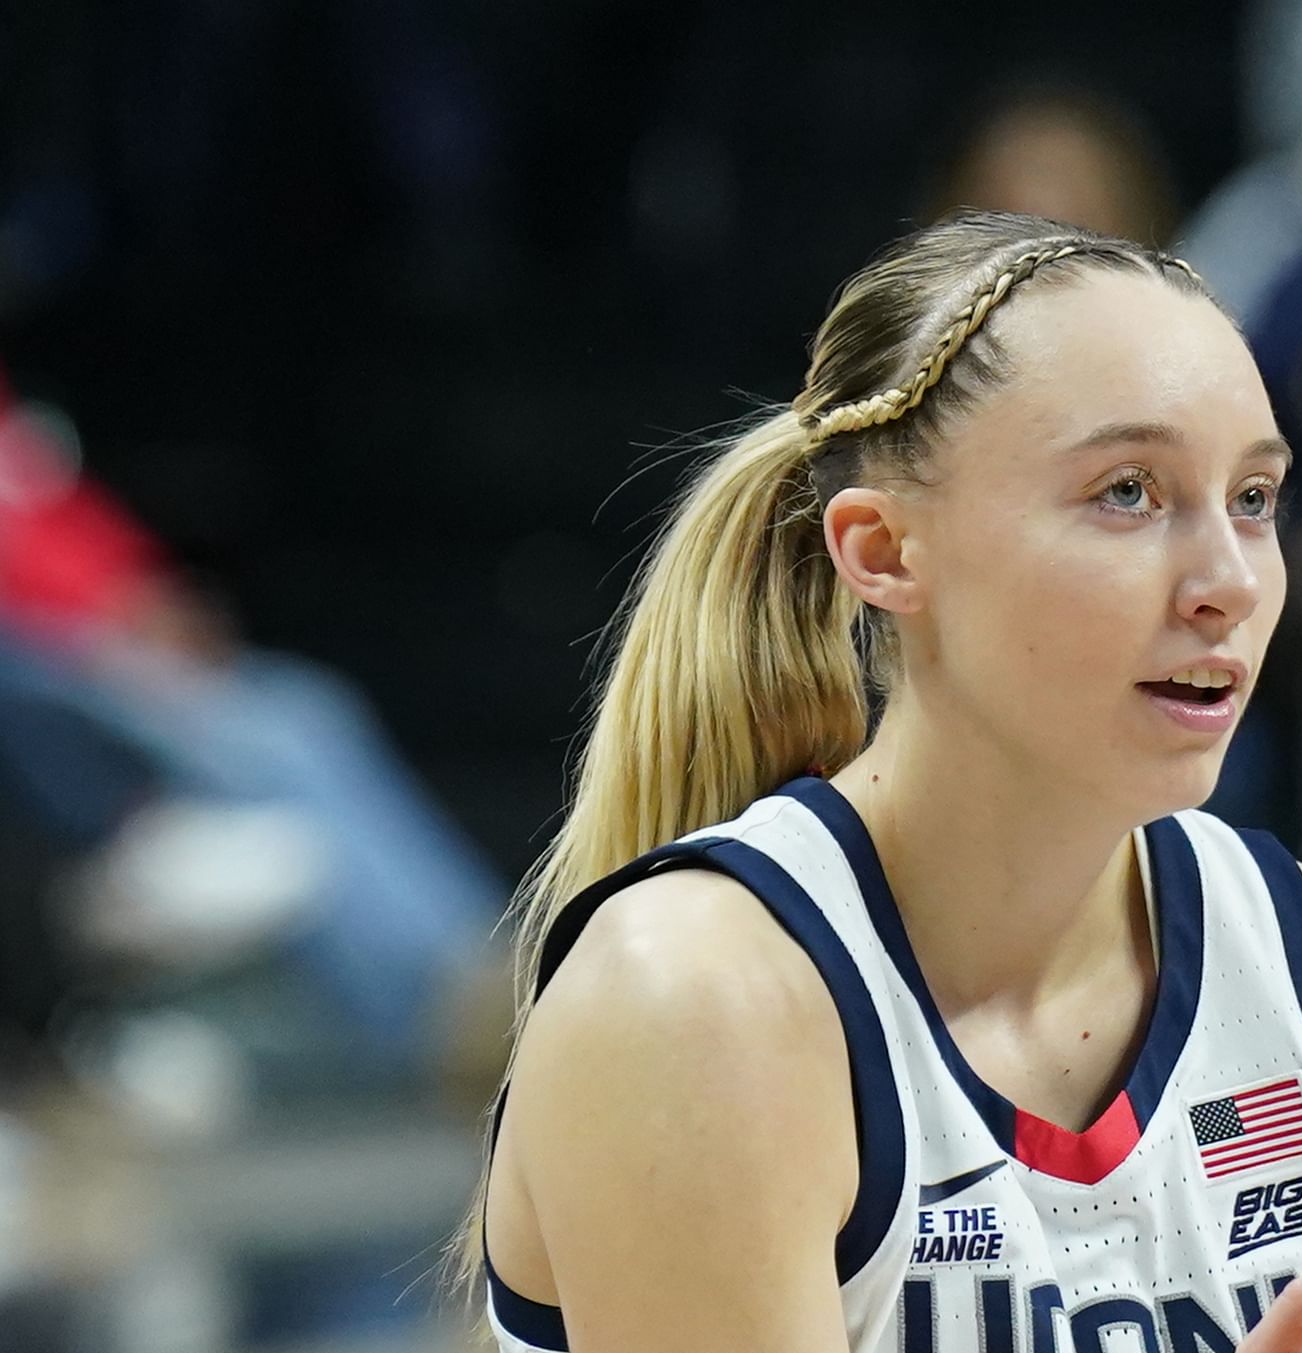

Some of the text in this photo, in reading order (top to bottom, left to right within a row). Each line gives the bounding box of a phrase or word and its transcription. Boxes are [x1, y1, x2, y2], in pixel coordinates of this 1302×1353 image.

[918, 1206, 998, 1234] E THE
[909, 1233, 1004, 1264] HANGE
